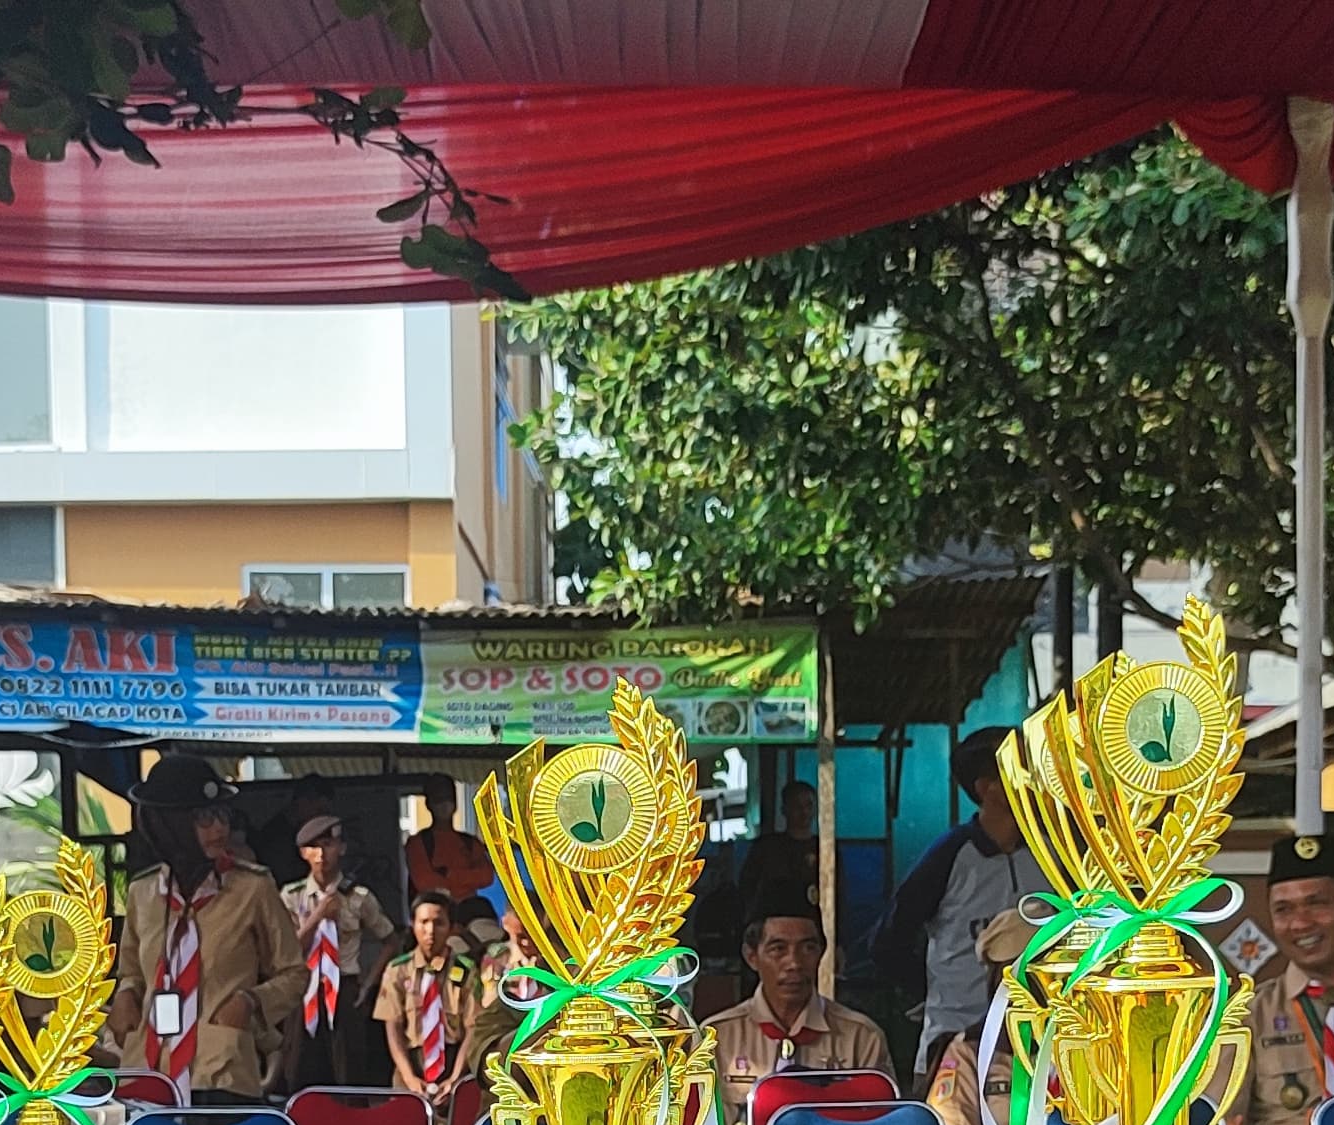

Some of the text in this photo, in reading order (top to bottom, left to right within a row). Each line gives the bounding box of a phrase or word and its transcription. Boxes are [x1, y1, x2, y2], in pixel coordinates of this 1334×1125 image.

[61, 625, 178, 675] AKI
[300, 648, 380, 661] STARTER
[473, 639, 612, 661] WARUNG
[70, 677, 113, 697] 1111
[120, 678, 186, 699] 7796
[441, 666, 514, 692] SOP
[525, 666, 553, 691] &
[215, 682, 381, 697] BISA TUKAR TAMBAH
[54, 702, 131, 720] CILACAP
[135, 704, 186, 721] KOTA
[215, 706, 262, 721] Gratis
[328, 707, 390, 723] Pasang
